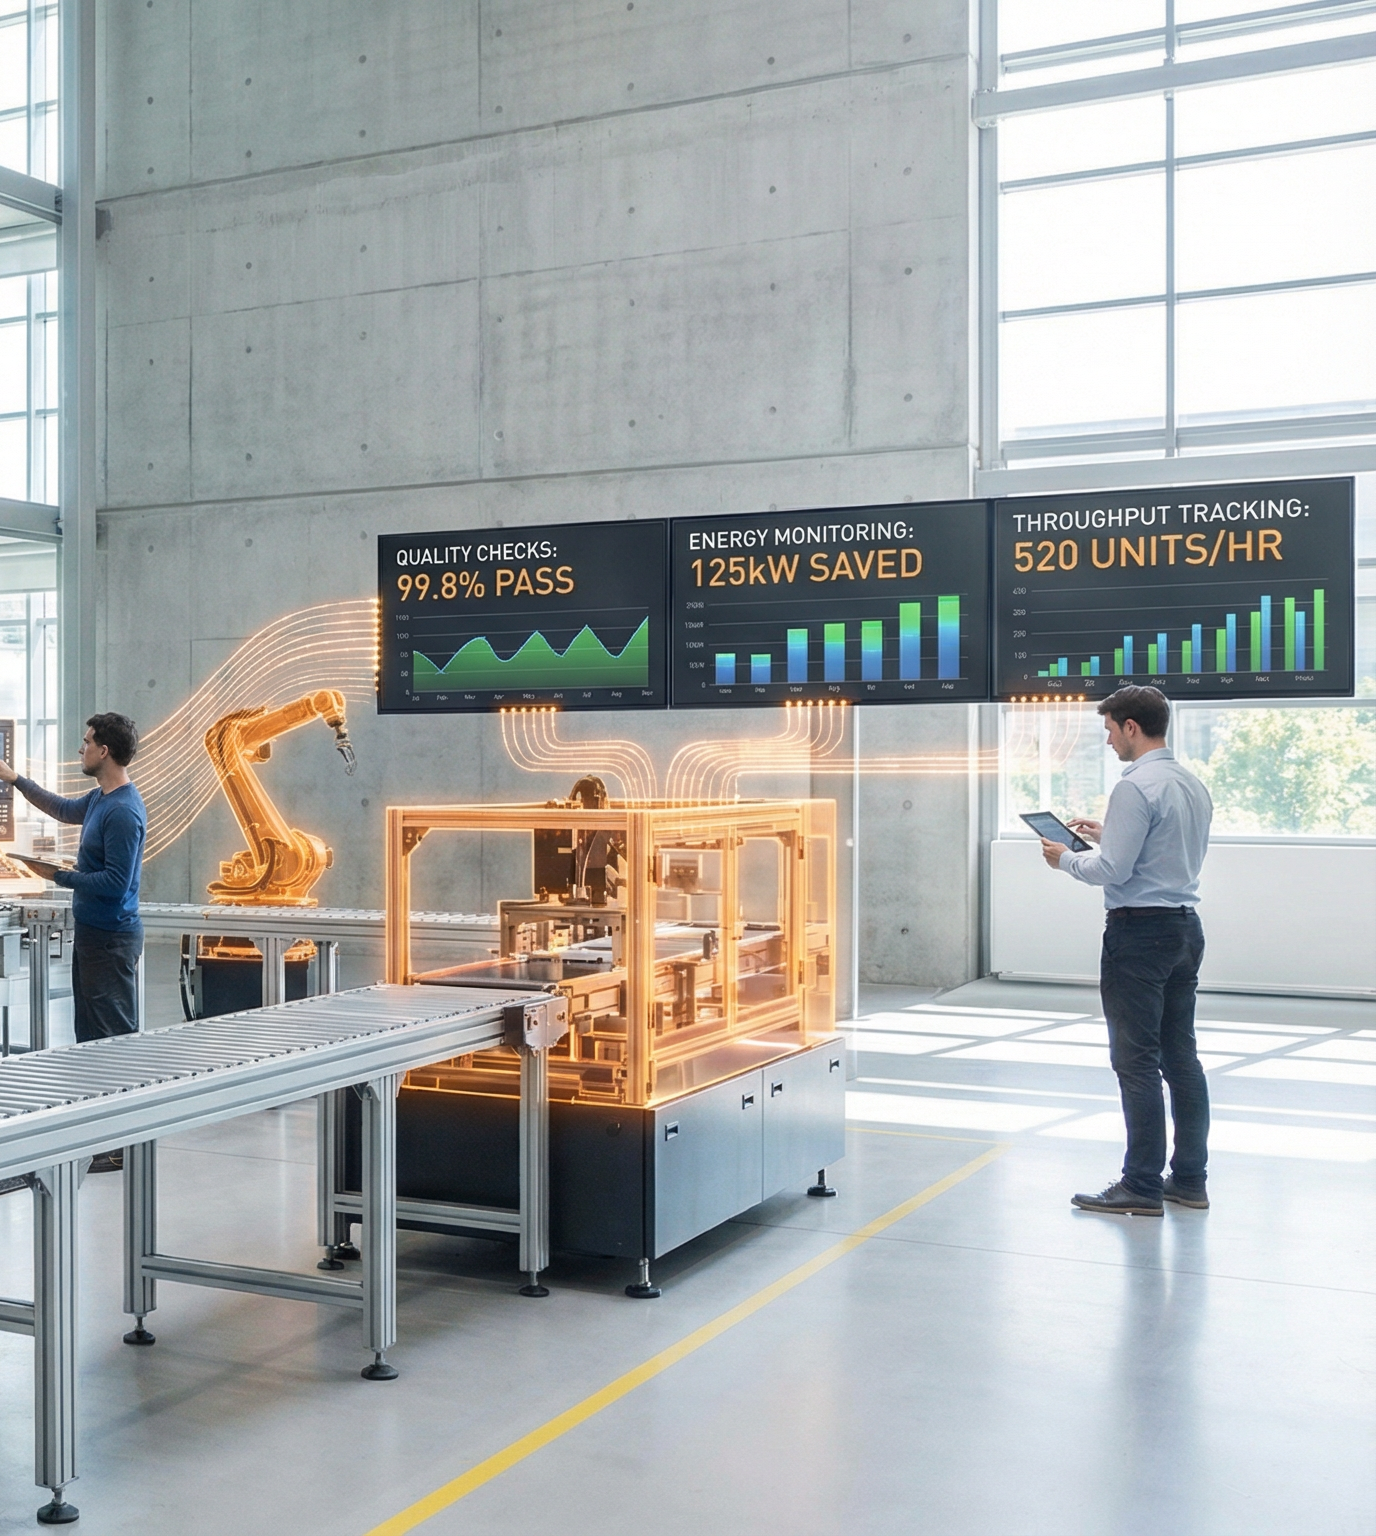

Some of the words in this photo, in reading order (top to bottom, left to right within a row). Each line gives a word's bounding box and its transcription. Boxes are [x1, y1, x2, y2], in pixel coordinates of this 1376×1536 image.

[1013, 505, 1172, 533] THROUGHPUT
[1178, 498, 1311, 524] TRACKING:
[689, 529, 768, 550] ENERGY
[774, 521, 915, 546] MONITORING:
[1014, 539, 1079, 572] 520
[1091, 529, 1283, 568] UNITS/HR
[396, 545, 472, 567] QUALITY
[476, 541, 558, 562] CHECKS:
[691, 553, 800, 587] 125kW
[809, 548, 923, 582] SAVED
[397, 570, 486, 602] 99.8%
[495, 565, 575, 597] PASS
